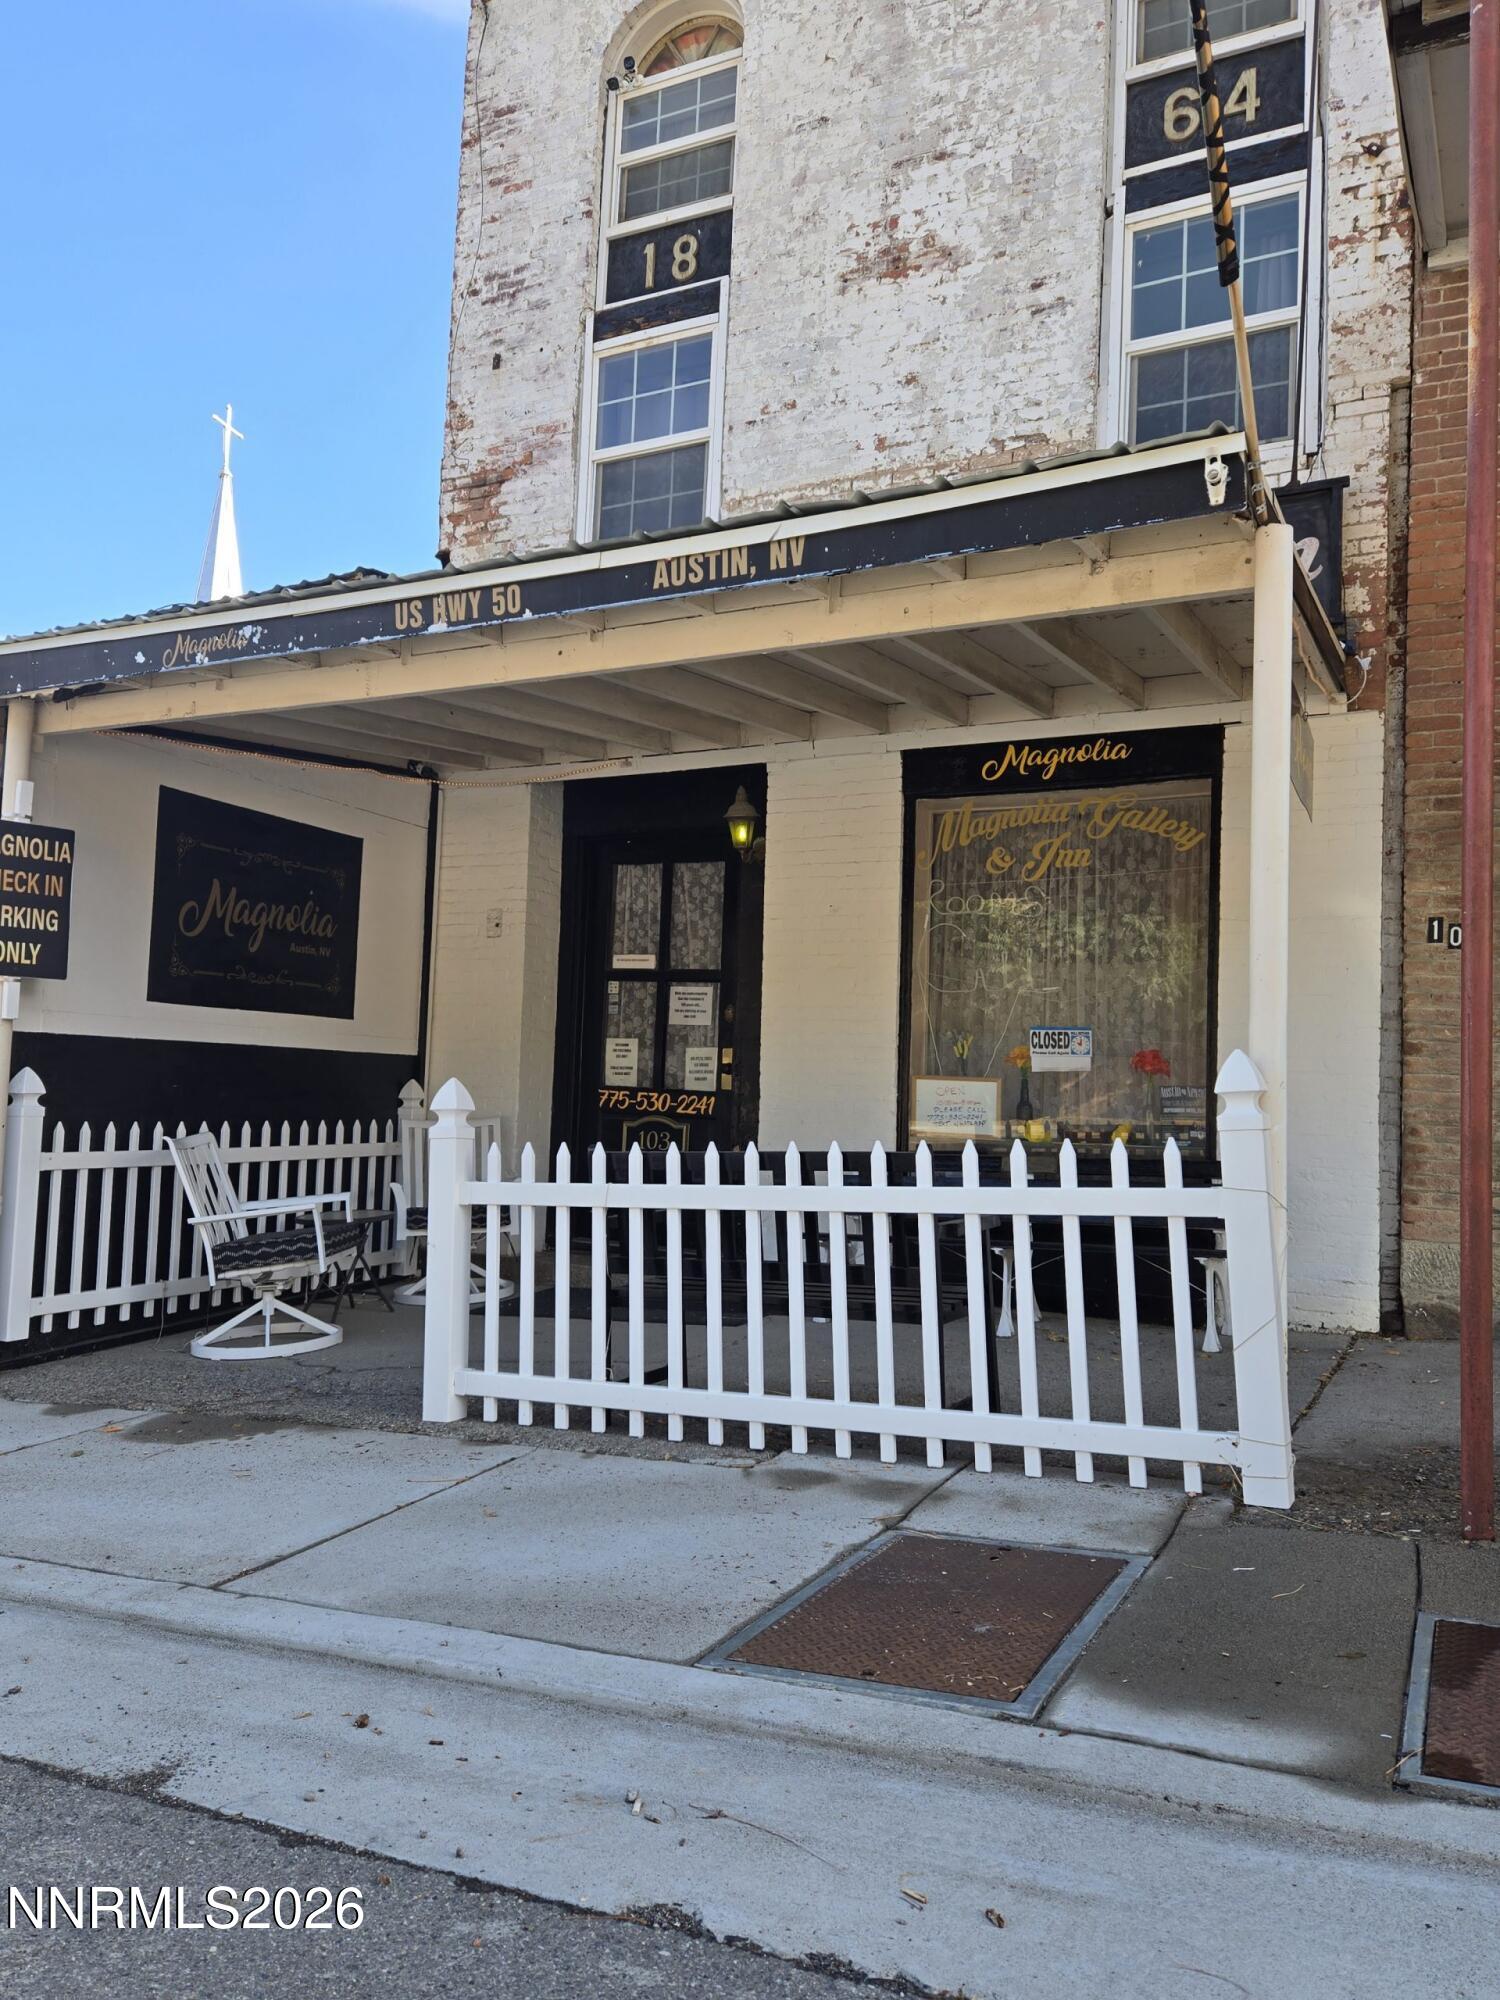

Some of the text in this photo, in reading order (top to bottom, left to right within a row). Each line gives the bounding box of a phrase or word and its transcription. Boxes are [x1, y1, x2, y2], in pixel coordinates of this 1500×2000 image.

[1163, 66, 1261, 142] 64
[643, 233, 698, 289] 18
[653, 536, 806, 590] AUSTIN, NV
[395, 584, 520, 630] US HWY 50
[162, 627, 249, 668] Magnolia
[981, 738, 1133, 781] Magnolia
[0, 833, 71, 864] GNOLIA
[918, 791, 1206, 870] Magnolia Gallery
[985, 831, 1093, 882] & Inn
[44, 874, 63, 897] IN
[178, 878, 338, 953] Magnolia
[1031, 1031, 1070, 1049] CLOSED
[598, 1089, 716, 1115] 775-530-2241
[639, 1130, 670, 1150] 103
